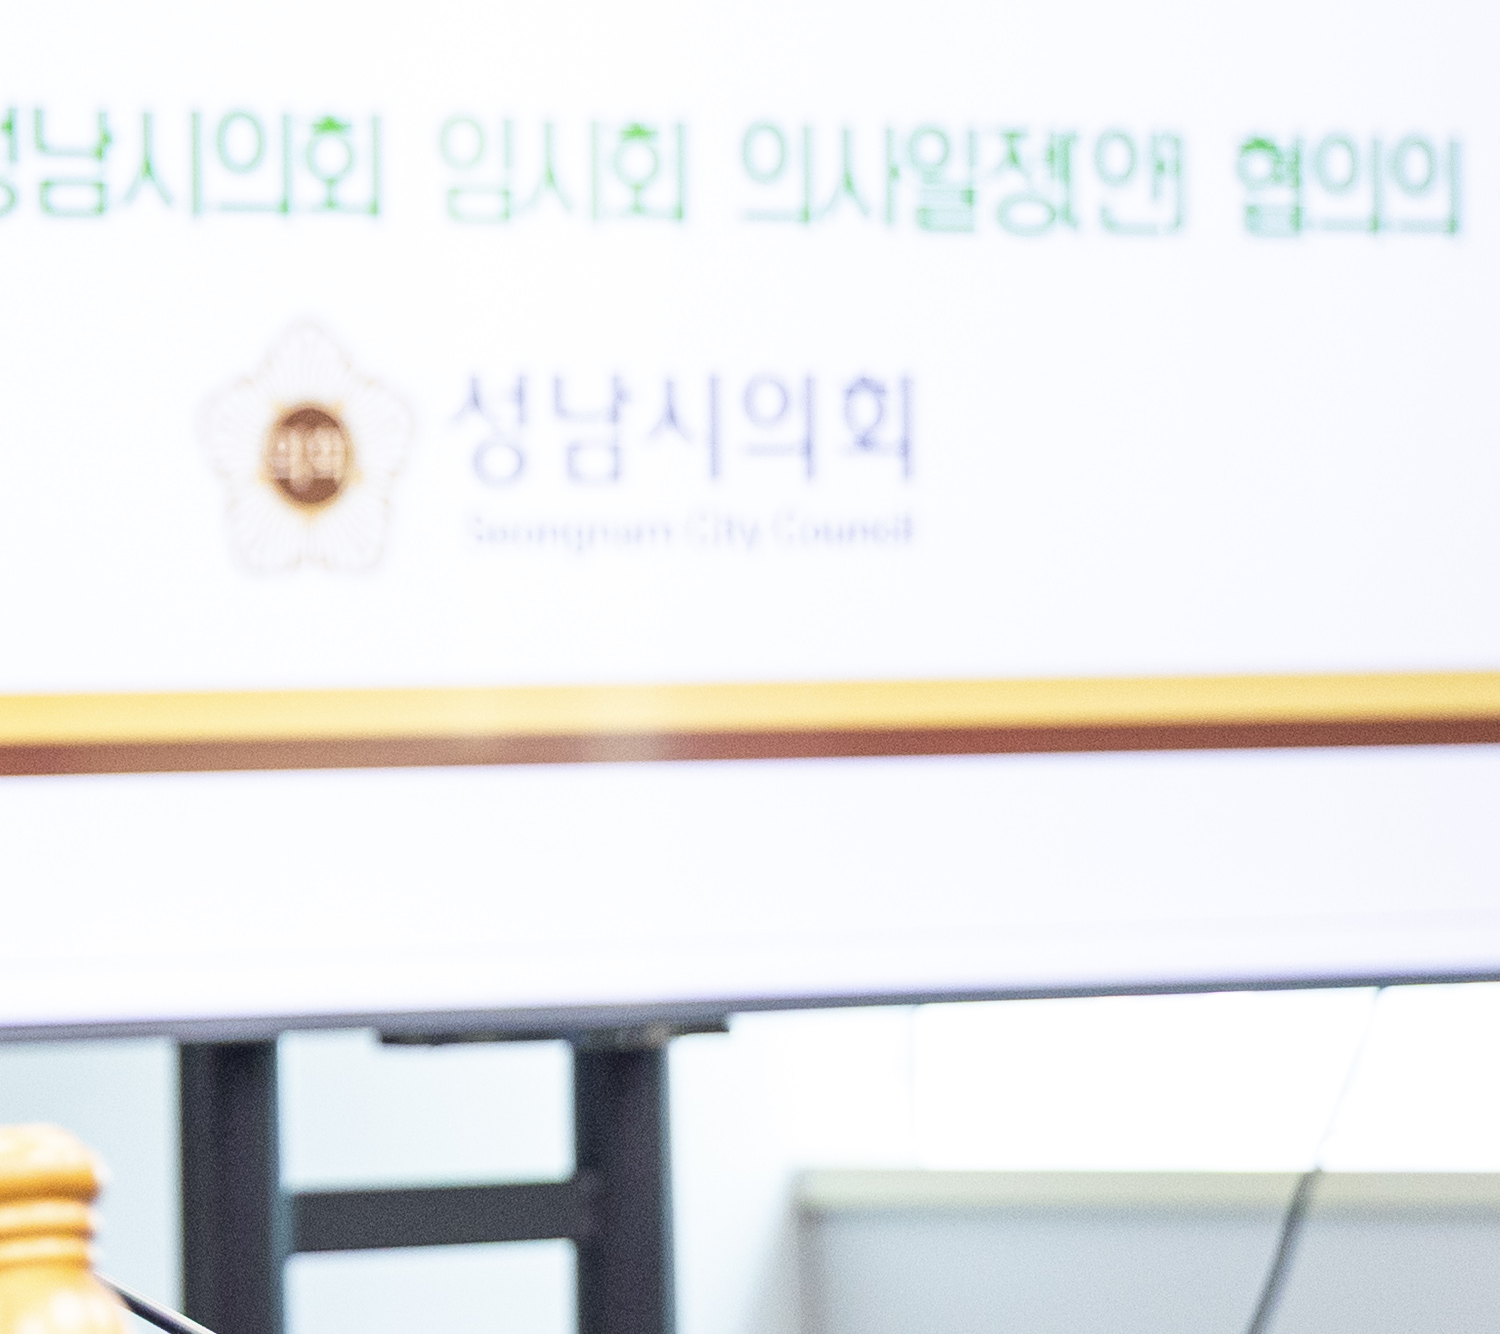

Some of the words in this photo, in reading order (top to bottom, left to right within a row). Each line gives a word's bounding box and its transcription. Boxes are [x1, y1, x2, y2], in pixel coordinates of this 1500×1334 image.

[437, 115, 691, 227] 임시회
[1235, 129, 1465, 239] 협의의
[454, 370, 917, 486] 성남시의회
